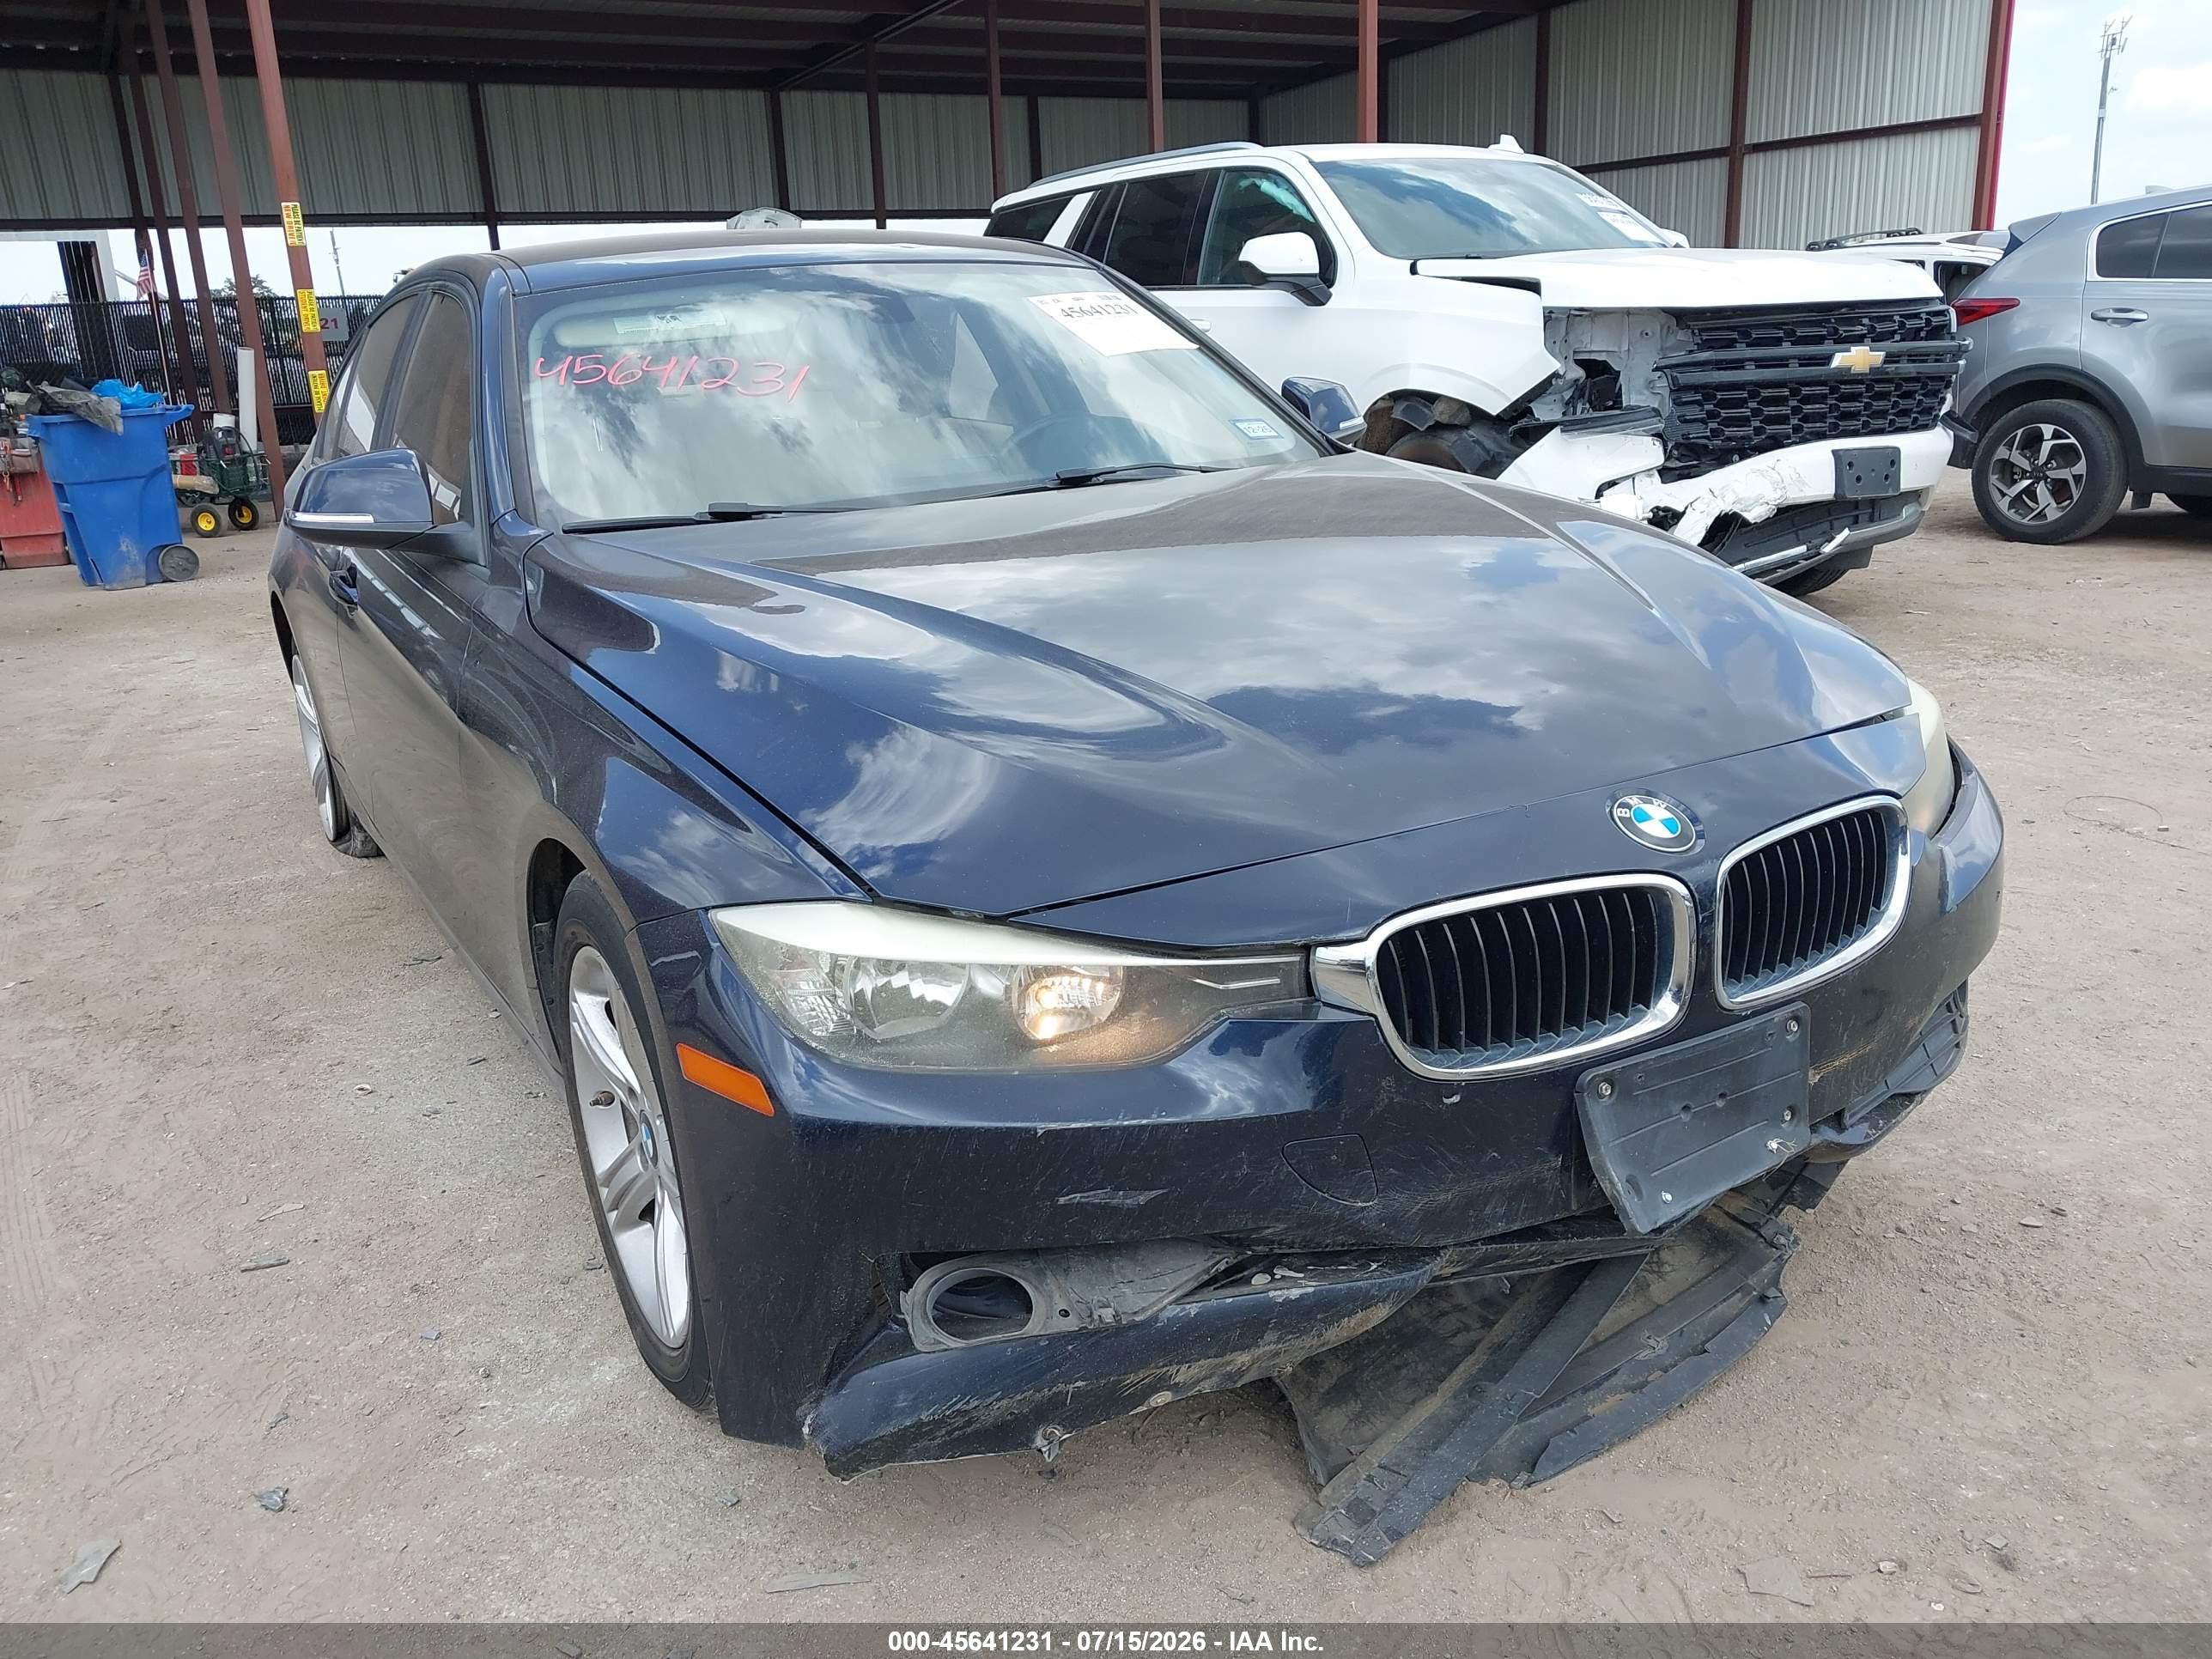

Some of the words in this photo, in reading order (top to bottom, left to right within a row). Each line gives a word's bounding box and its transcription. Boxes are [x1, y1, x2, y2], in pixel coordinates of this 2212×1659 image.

[283, 205, 292, 219] NEW
[286, 221, 296, 245] DRIVER
[295, 226, 304, 244] PATIENT
[300, 291, 308, 311] STUDENT
[1060, 304, 1139, 319] 45641231
[319, 318, 338, 330] 21
[534, 354, 811, 404] 45641231
